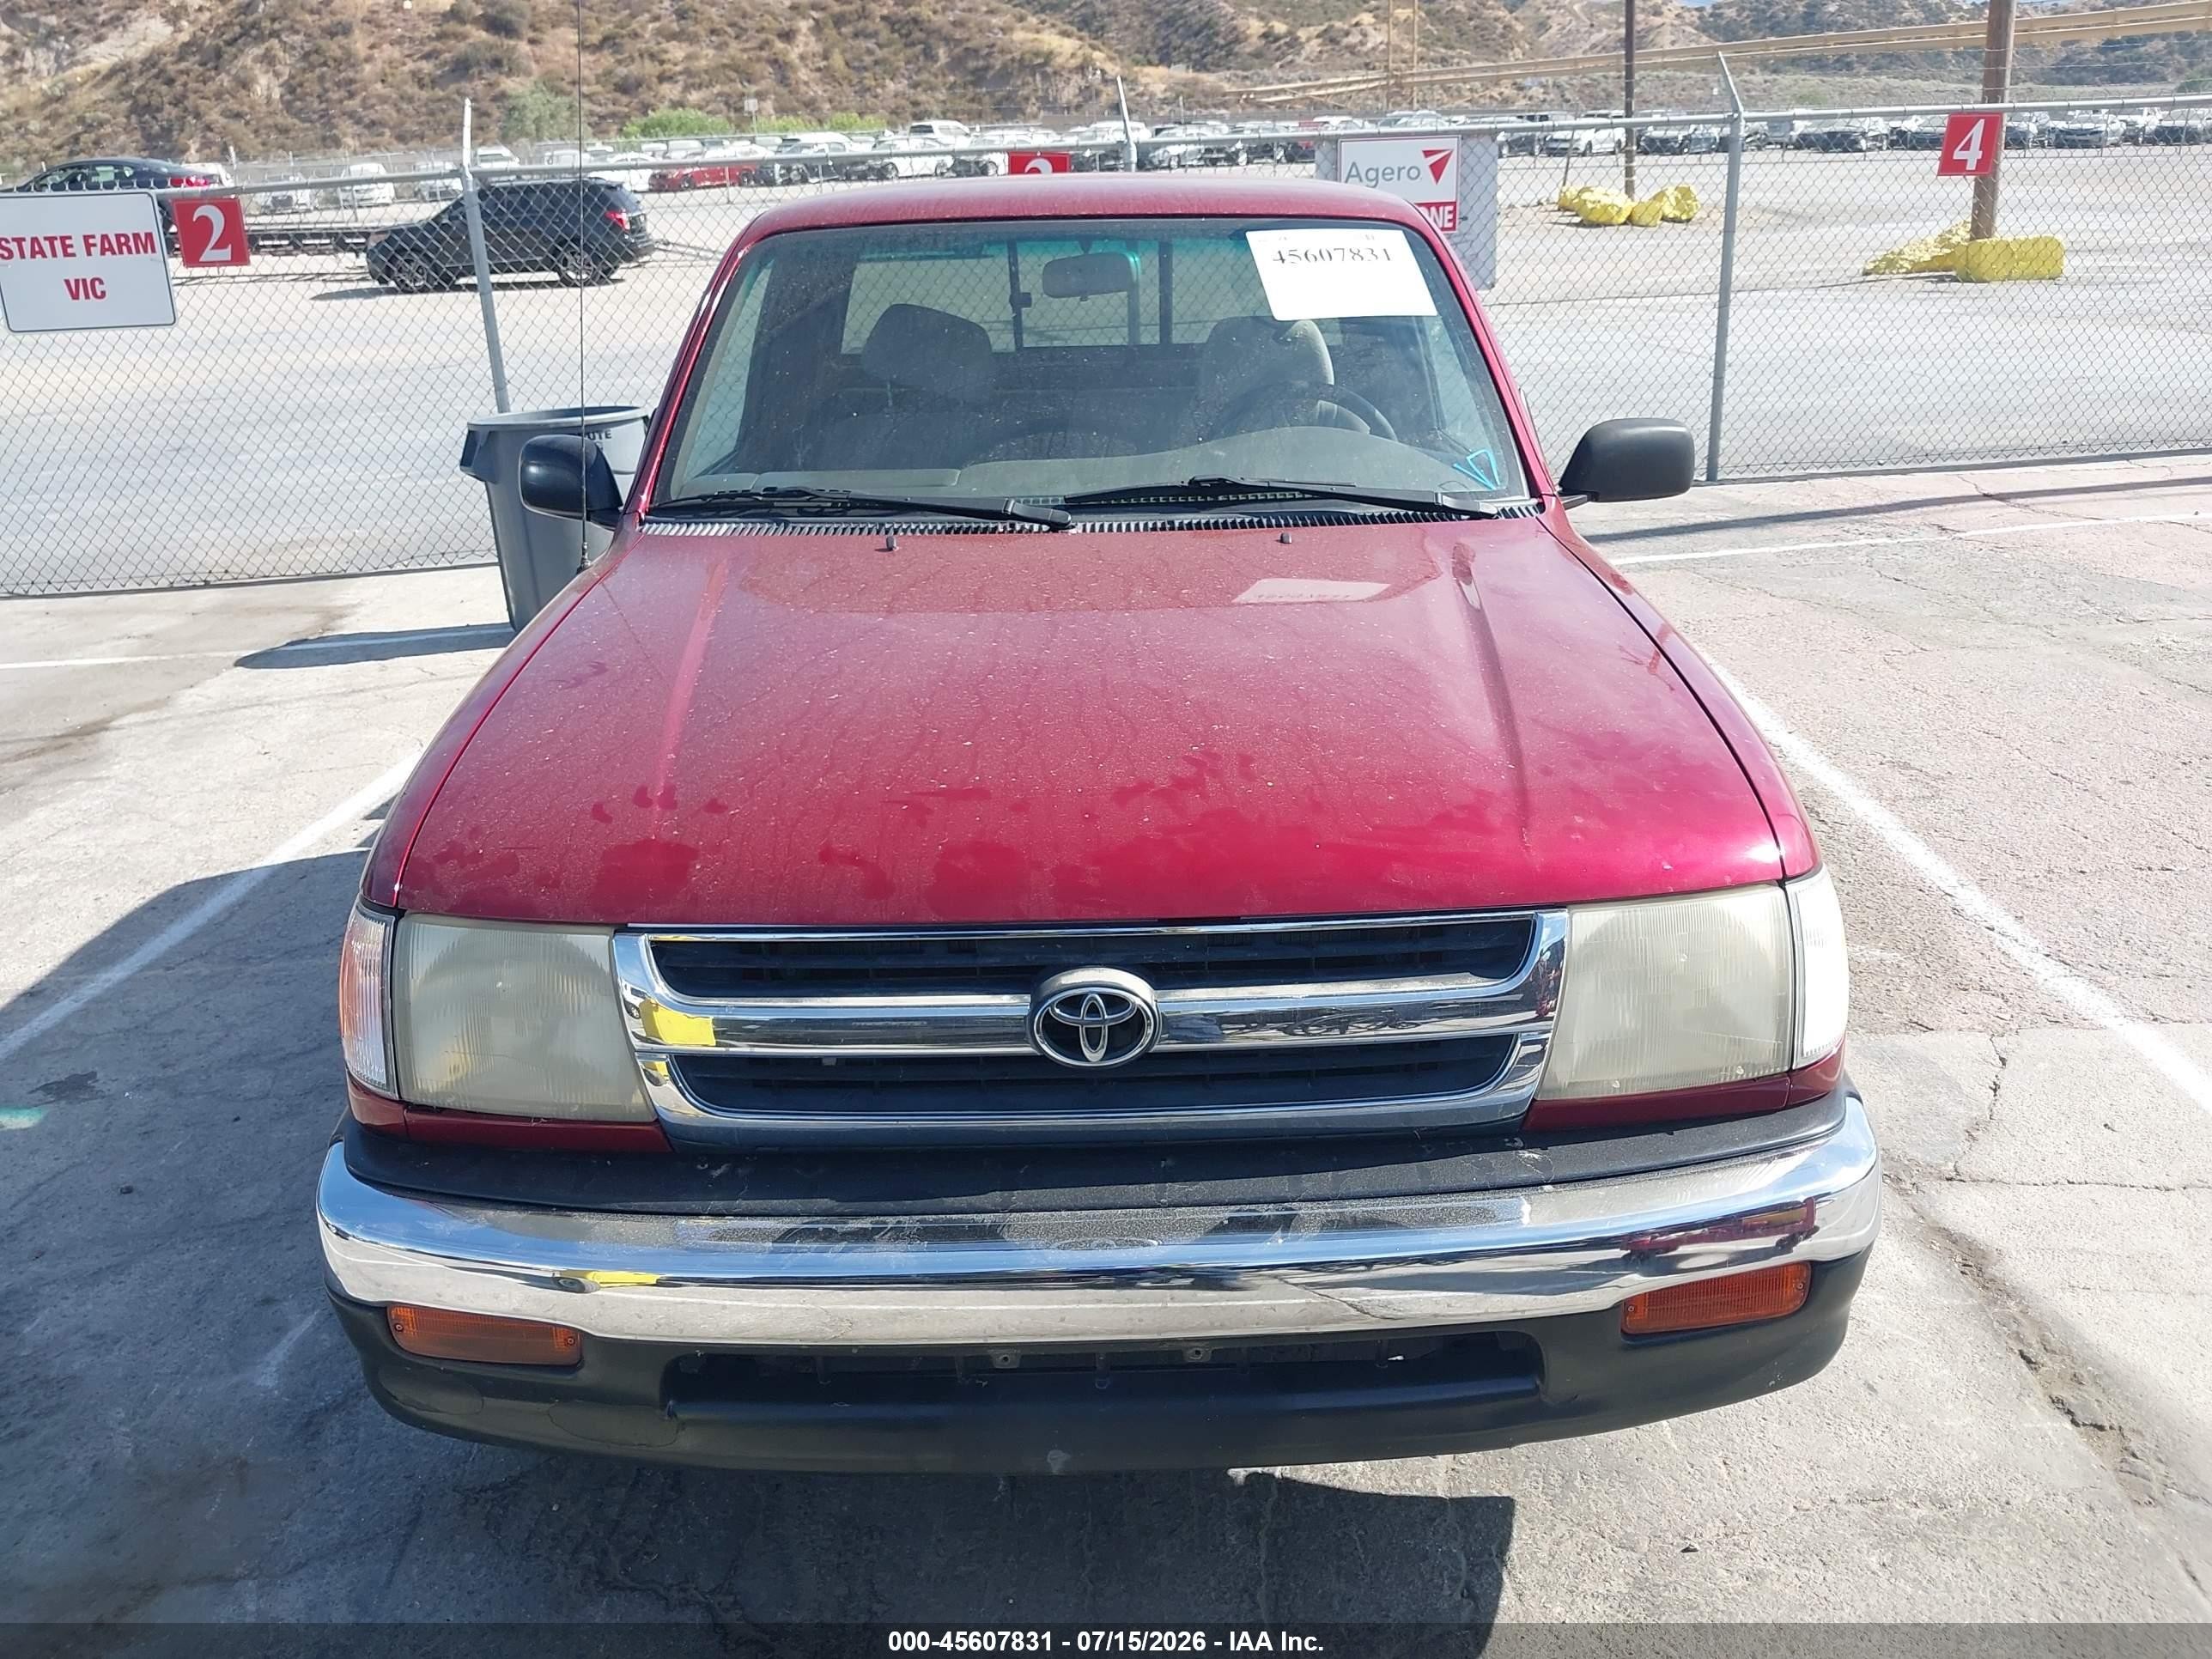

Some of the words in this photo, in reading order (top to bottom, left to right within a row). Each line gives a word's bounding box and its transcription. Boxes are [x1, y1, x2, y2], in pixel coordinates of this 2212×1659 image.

[1953, 118, 1985, 170] 4
[1345, 161, 1421, 188] Agero
[0, 235, 76, 260] STATE
[82, 232, 157, 257] FARM
[193, 204, 233, 262] 2
[1273, 248, 1391, 264] 45607831
[64, 276, 106, 301] VIC
